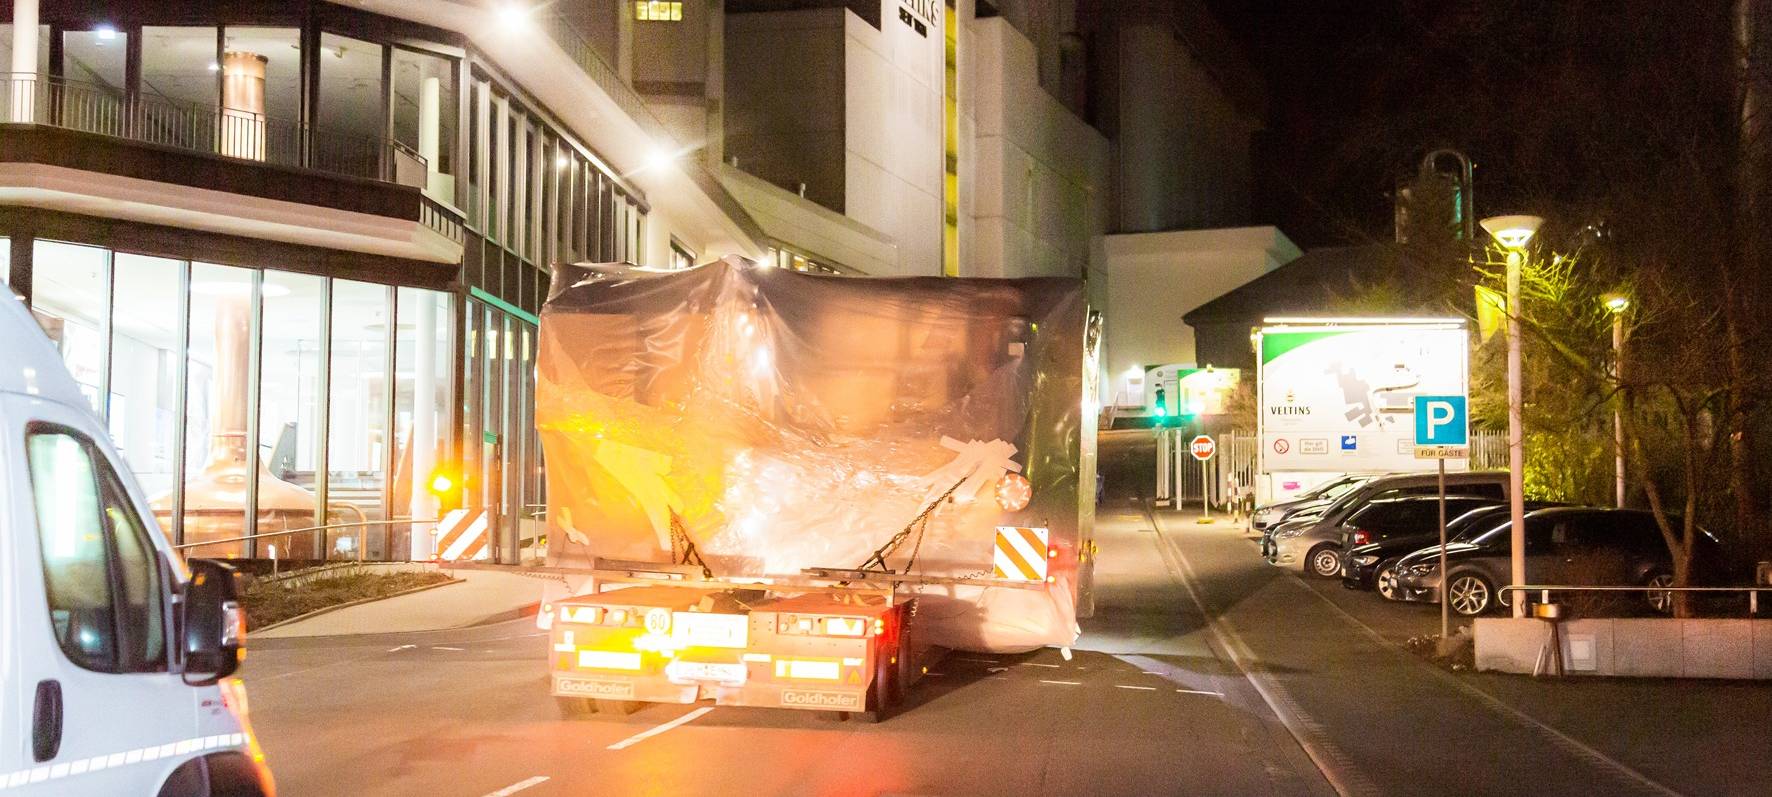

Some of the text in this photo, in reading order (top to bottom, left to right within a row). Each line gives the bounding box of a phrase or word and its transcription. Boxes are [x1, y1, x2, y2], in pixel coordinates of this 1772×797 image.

[1271, 406, 1311, 415] VELTINS
[1426, 401, 1455, 440] P
[1193, 442, 1213, 453] STOP
[560, 680, 632, 695] Goldhofer
[785, 692, 857, 706] Goldhofer
